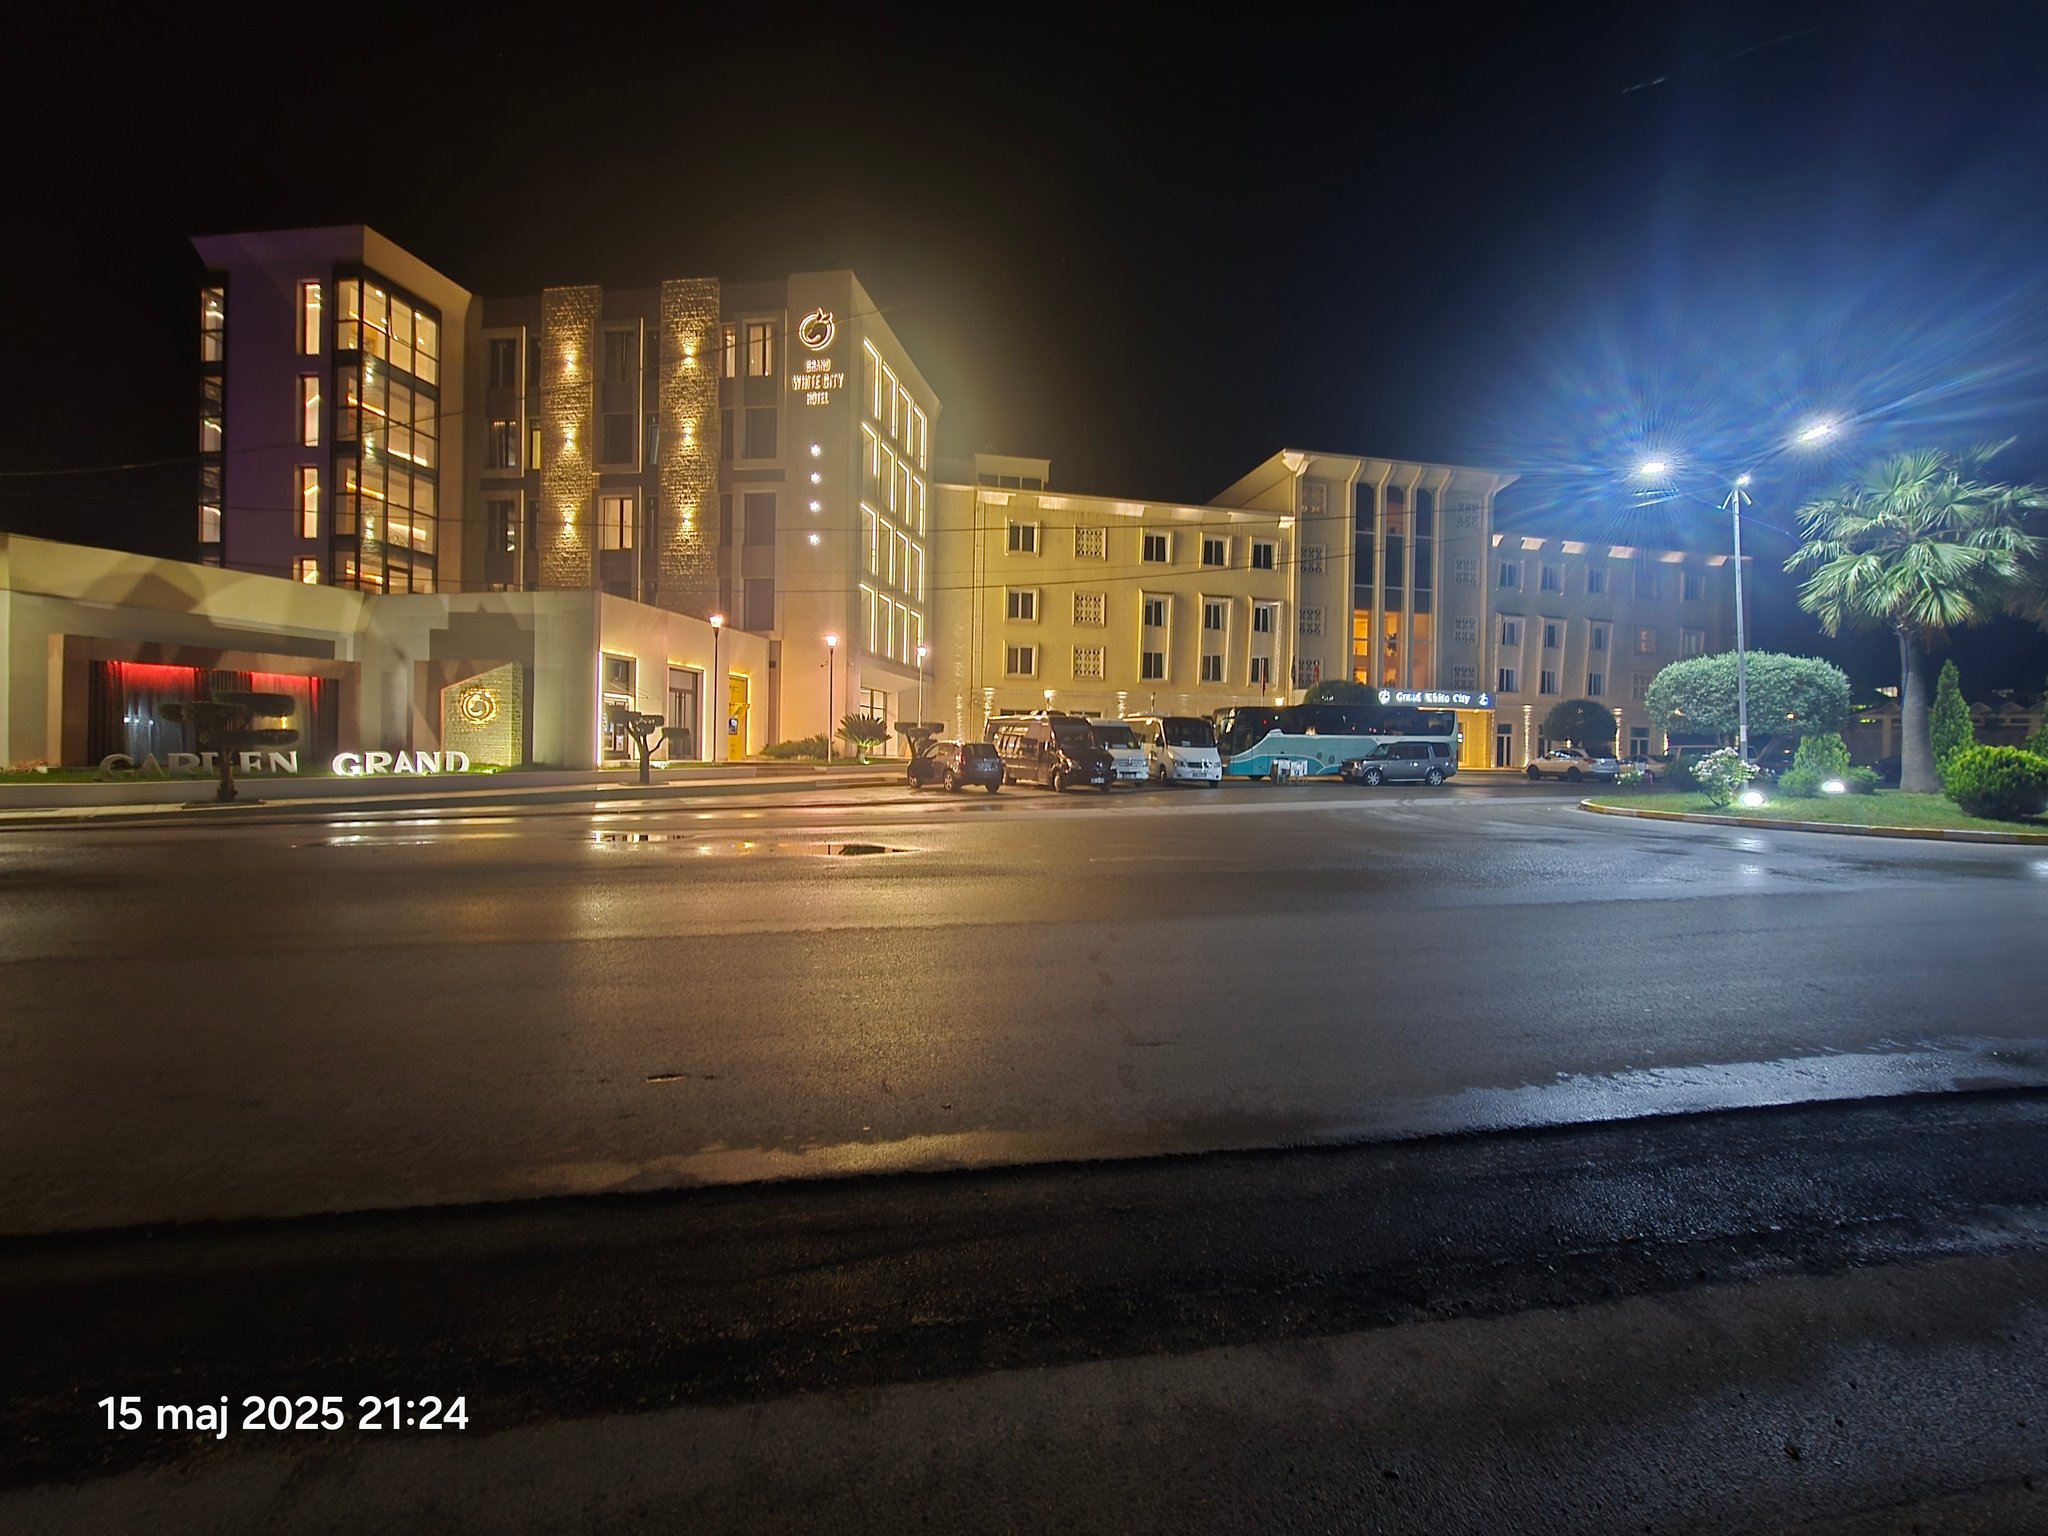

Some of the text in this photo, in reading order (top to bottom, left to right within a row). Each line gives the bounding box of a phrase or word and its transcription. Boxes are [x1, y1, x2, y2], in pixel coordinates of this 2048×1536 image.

[792, 374, 821, 390] WHITE
[806, 391, 829, 405] HOTEL
[1395, 692, 1471, 704] Grand White City
[332, 750, 470, 776] GRAND
